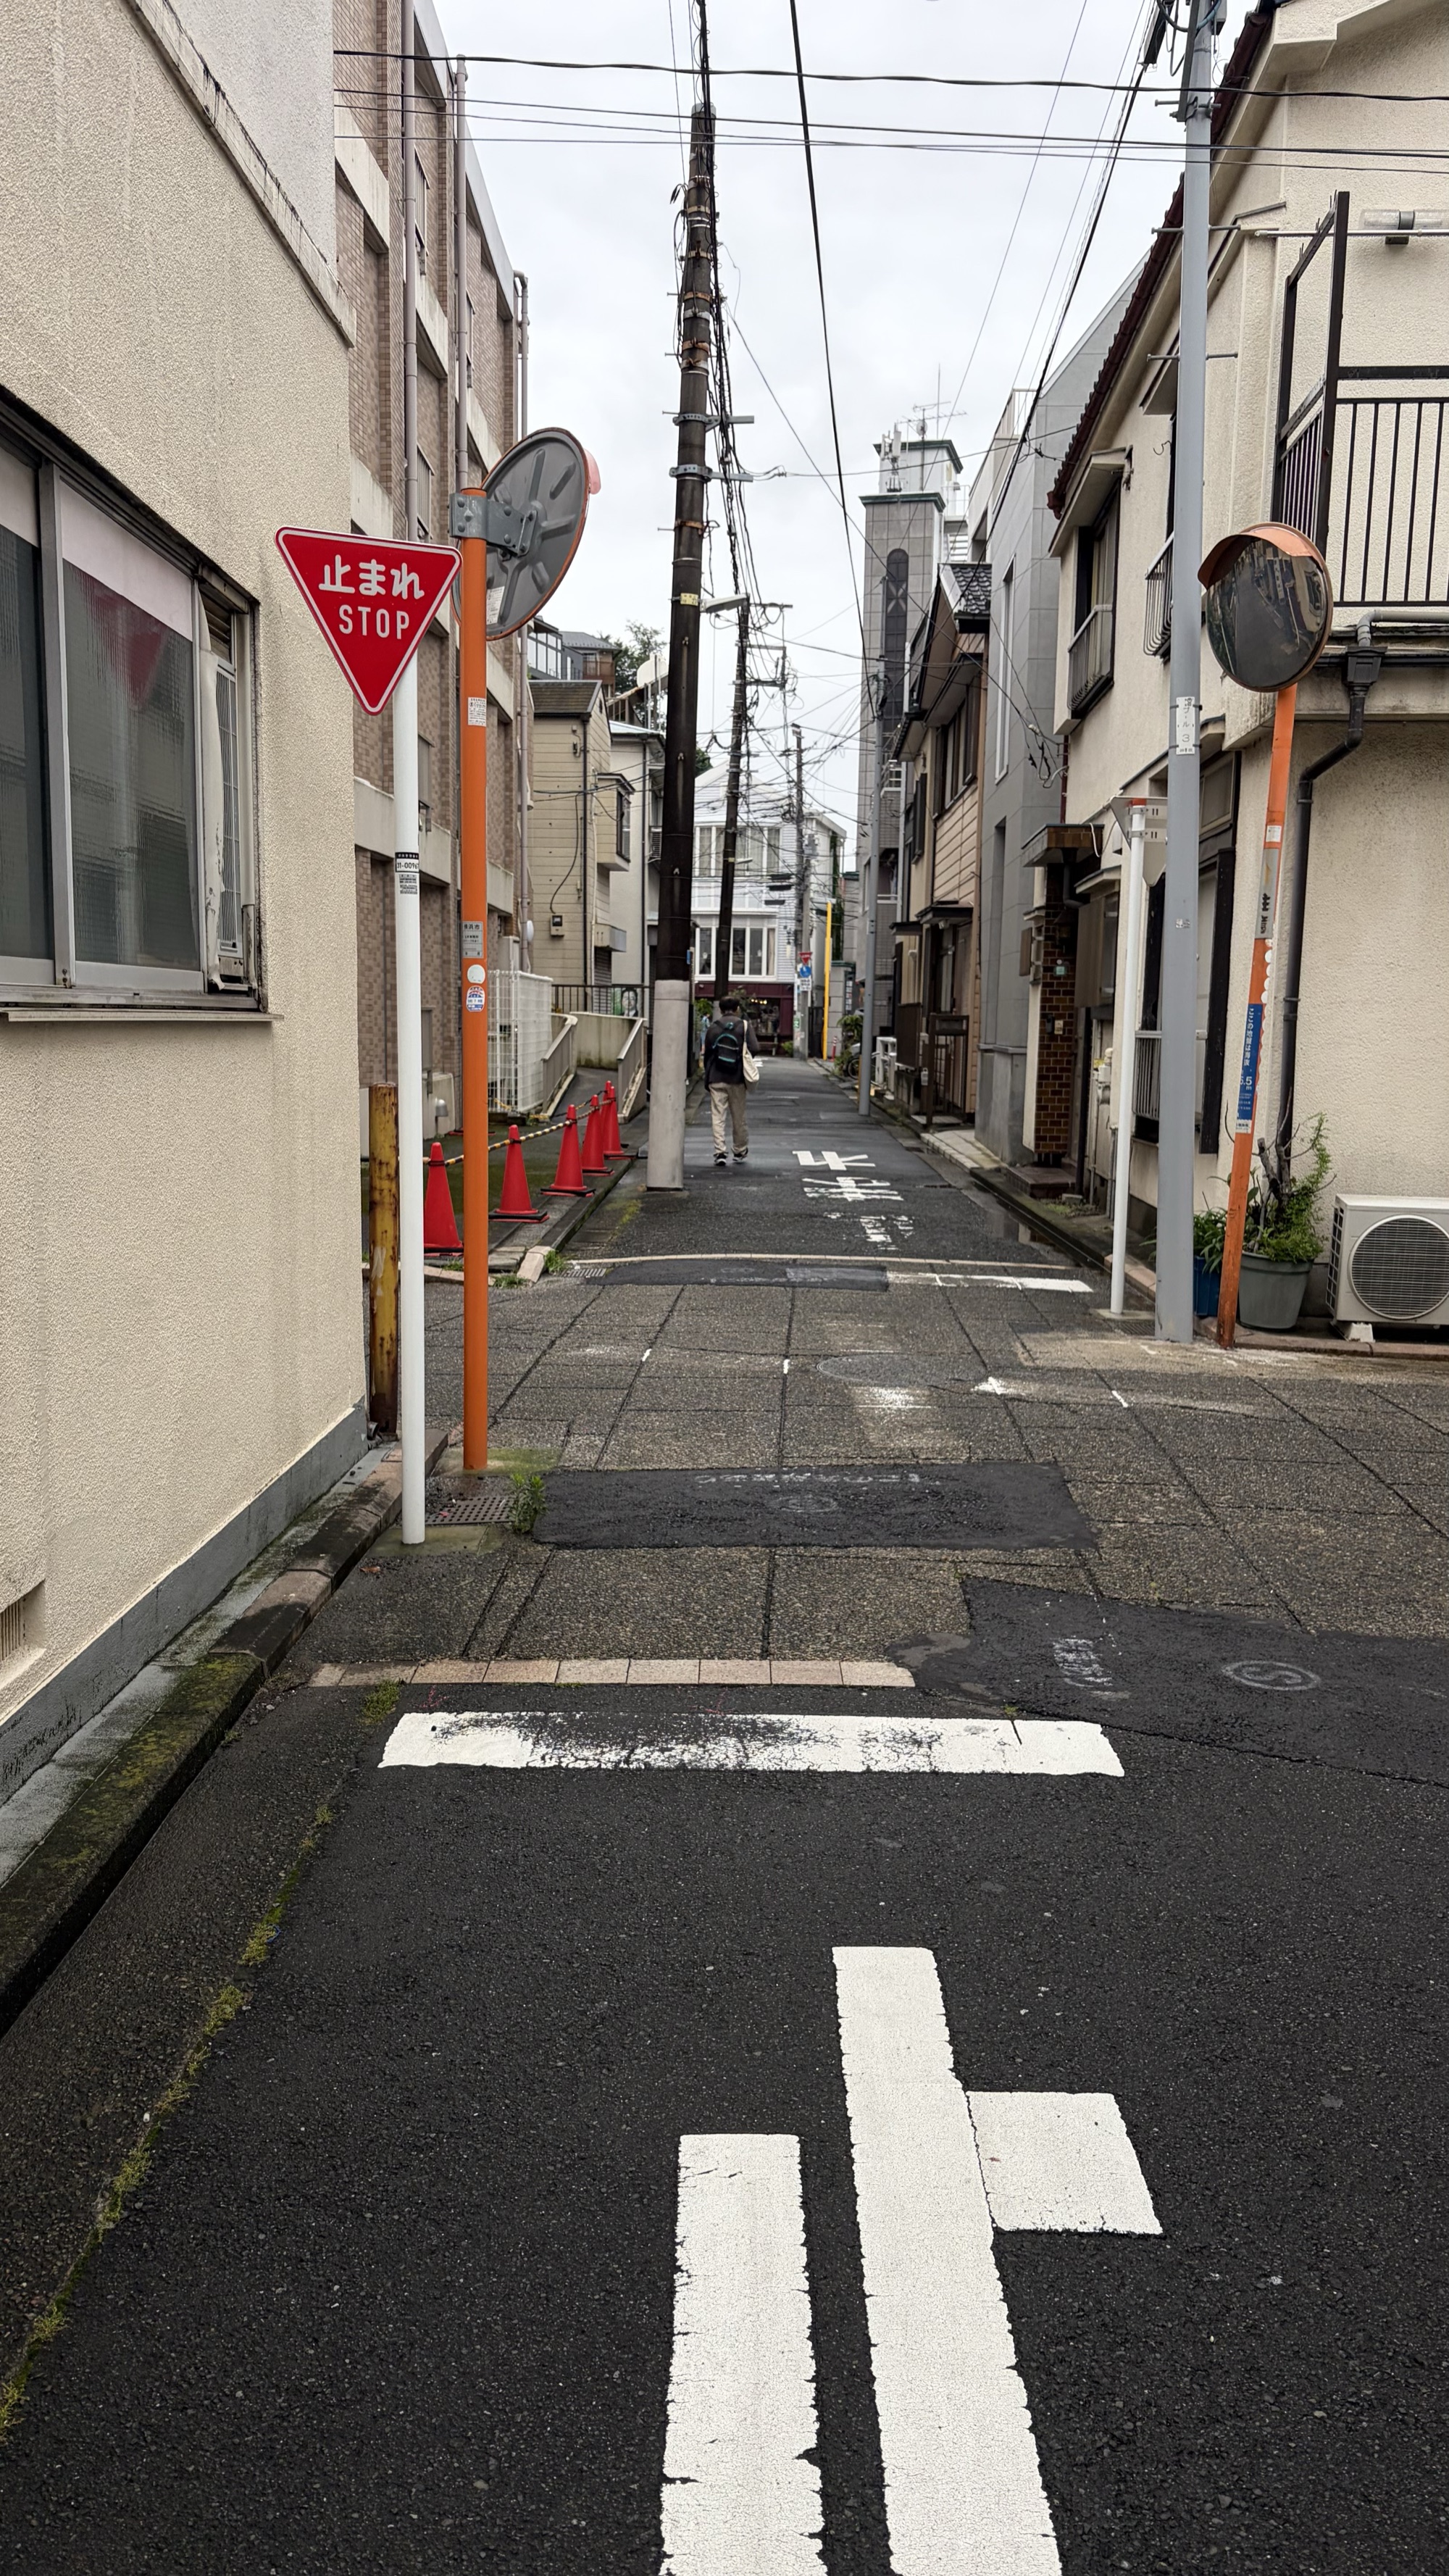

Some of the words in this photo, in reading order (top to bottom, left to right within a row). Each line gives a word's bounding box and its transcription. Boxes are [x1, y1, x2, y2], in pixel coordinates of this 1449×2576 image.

[318, 554, 425, 600] 止まれ
[338, 604, 410, 639] STOP
